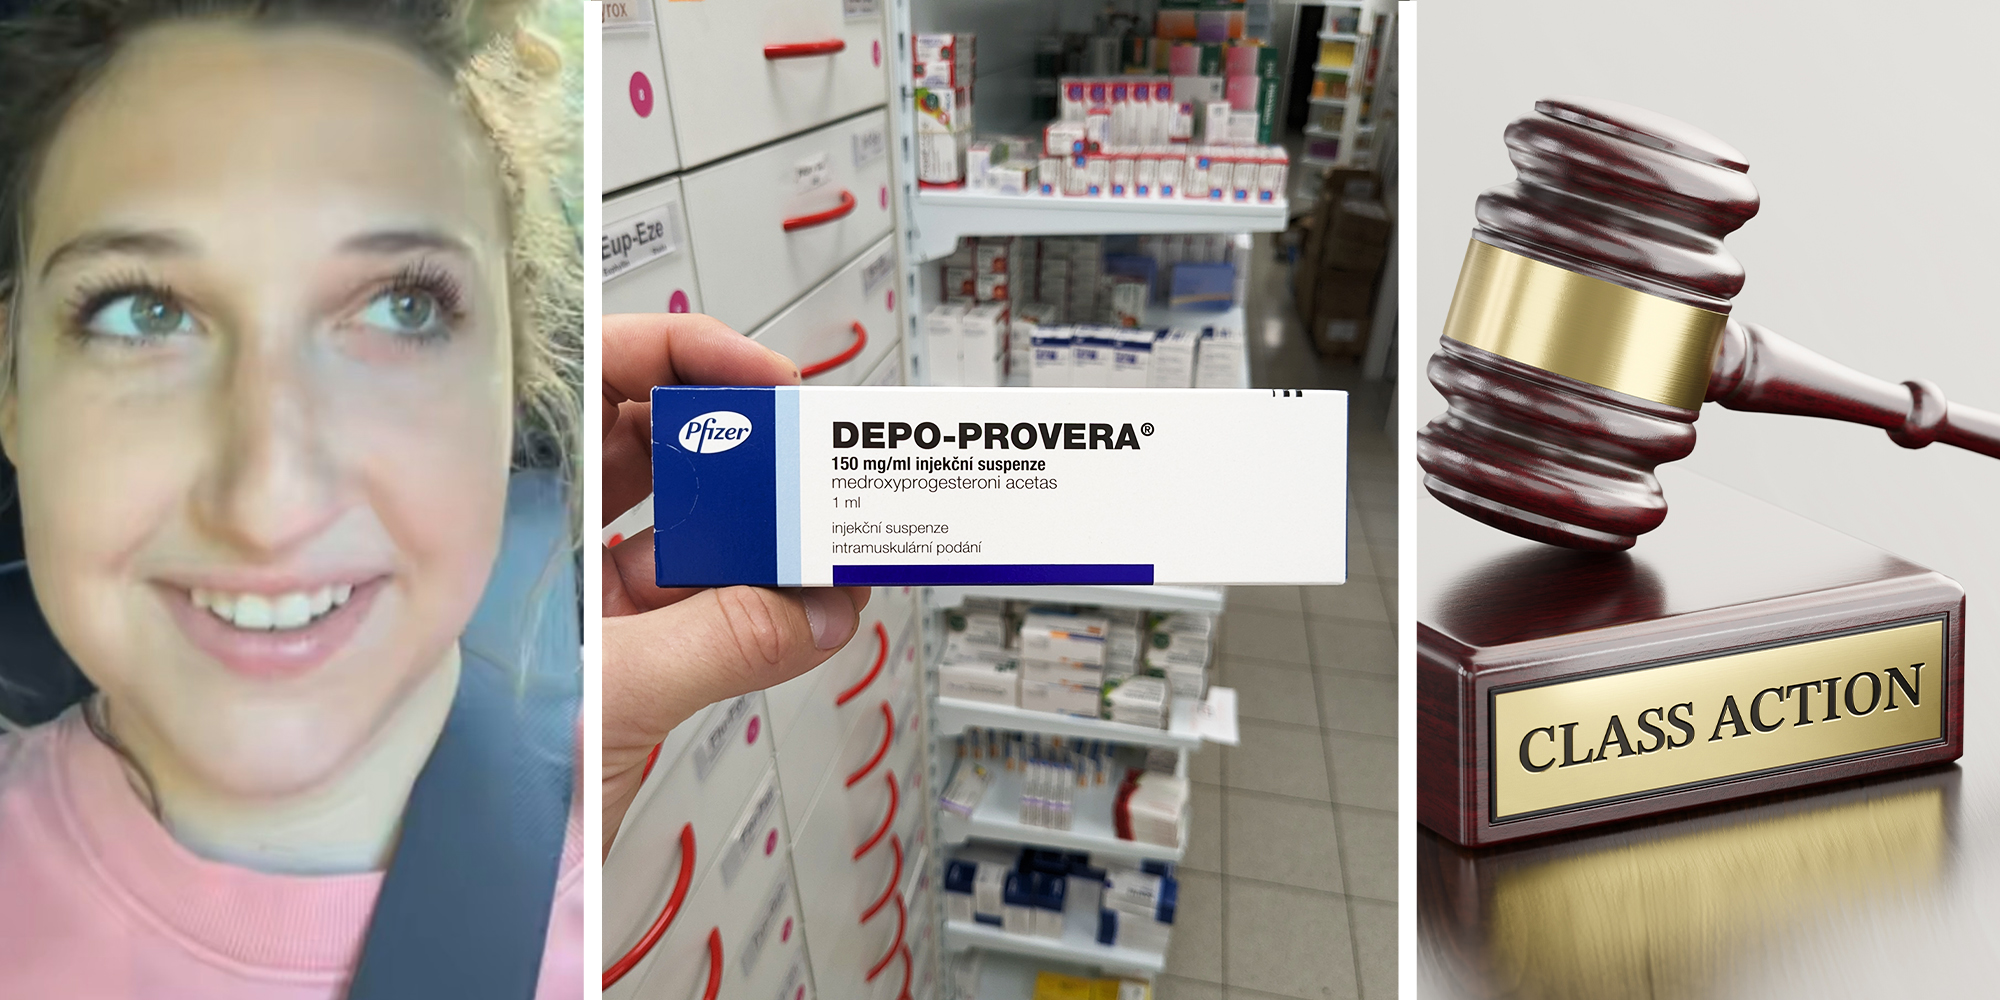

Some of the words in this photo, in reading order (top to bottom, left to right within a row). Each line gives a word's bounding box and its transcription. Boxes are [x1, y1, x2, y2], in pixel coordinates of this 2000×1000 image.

[685, 417, 749, 453] Pfizer
[831, 456, 859, 471] 150
[863, 456, 911, 474] mg/ml
[915, 455, 974, 474] injekční
[977, 459, 1046, 474] suspenze
[831, 475, 1001, 492] medroxyprogesteroni
[1005, 475, 1058, 490] acetas
[832, 496, 839, 508] 1
[845, 496, 861, 508] ml
[832, 521, 882, 536] injekční
[885, 524, 949, 536] suspenze
[832, 541, 933, 554] intramuskulární
[936, 540, 982, 555] podání
[1519, 701, 1696, 773] CLASS
[1708, 662, 1927, 743] ACTION
